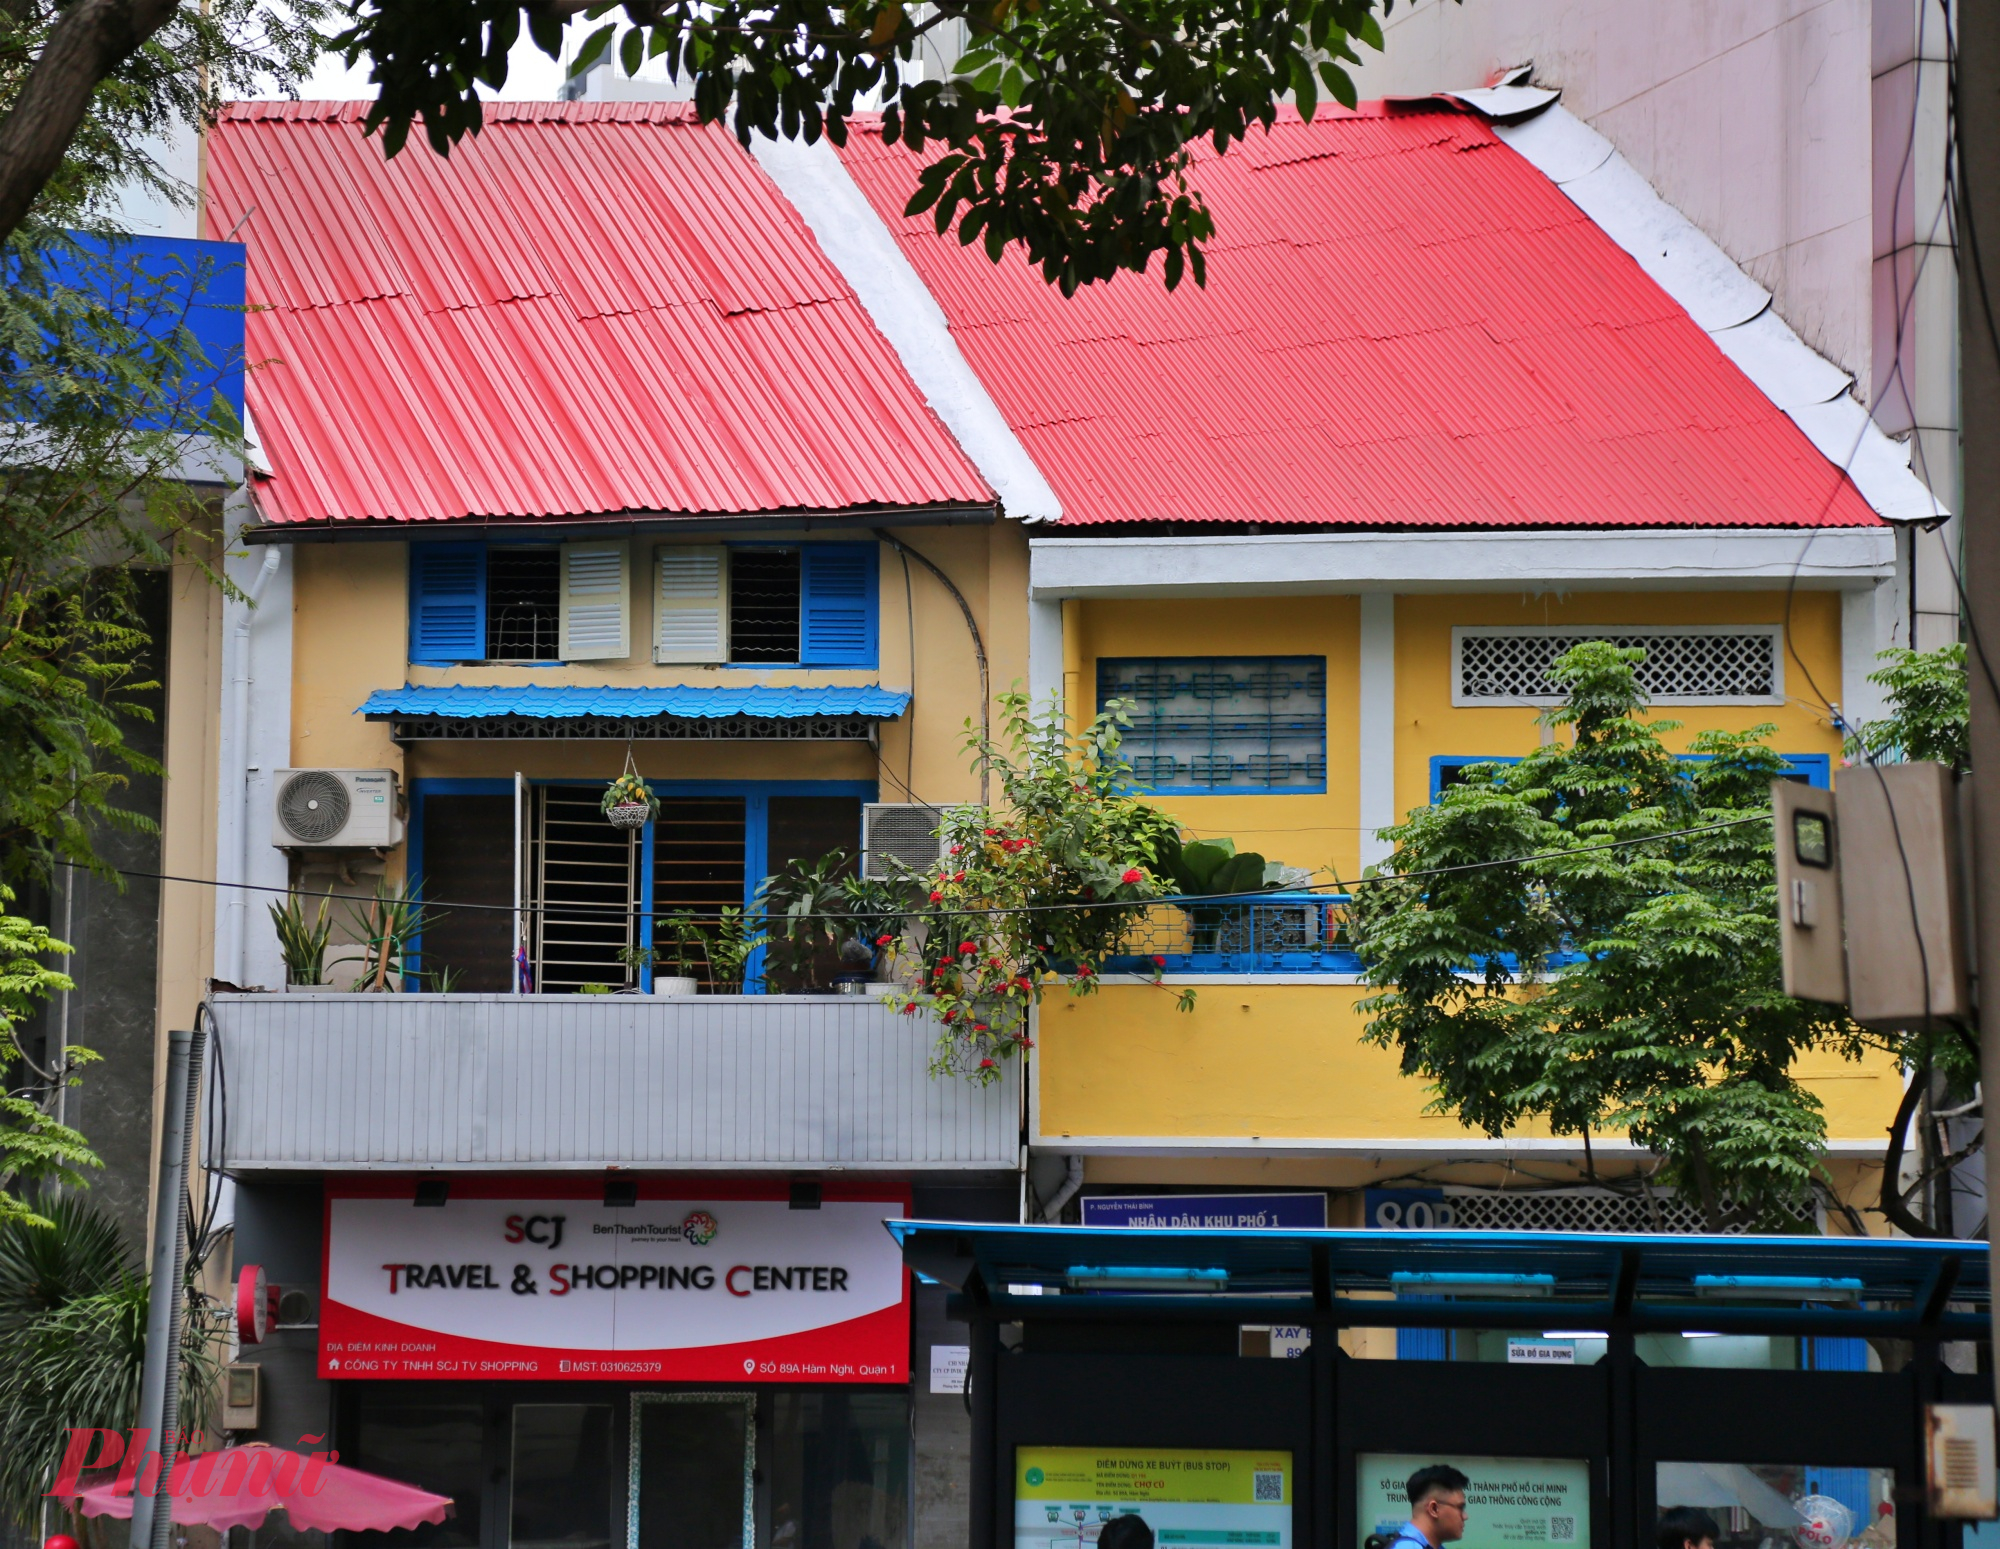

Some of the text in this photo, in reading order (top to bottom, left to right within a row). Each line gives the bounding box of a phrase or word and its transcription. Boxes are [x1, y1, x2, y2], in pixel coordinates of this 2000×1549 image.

[1124, 1202, 1138, 1210] THÁI
[1138, 1202, 1154, 1210] BÌNH
[1128, 1209, 1279, 1228] NHÂN DÂN KHU PHỐ 1
[504, 1214, 567, 1250] SCJ
[592, 1223, 682, 1236] BenThanhTourist
[382, 1264, 849, 1297] TRAVEL & SHOPPING CENTER
[1274, 1327, 1301, 1339] XAY
[375, 1343, 398, 1352] KINH
[401, 1343, 436, 1352] DOANH
[1538, 1350, 1551, 1358] GIA
[344, 1358, 538, 1372] CÔNG TY TNHH SCJ TV SHOPPING
[573, 1361, 662, 1373] MST: 0310625379
[779, 1363, 800, 1374] 89A
[802, 1362, 826, 1374] Hàm
[890, 1364, 896, 1374] 1
[1146, 1461, 1157, 1470] XE
[1183, 1461, 1203, 1472] (BUS
[1205, 1461, 1231, 1472] STOP)
[1380, 1479, 1391, 1490] SỞ
[1392, 1481, 1408, 1490] GIA
[1473, 1481, 1500, 1492] THÀNH
[1501, 1480, 1518, 1493] PHỐ
[1532, 1482, 1545, 1493] CHÍ
[1546, 1484, 1568, 1494] MINH
[1468, 1495, 1487, 1505] GIAO
[1489, 1494, 1516, 1506] THÔNG
